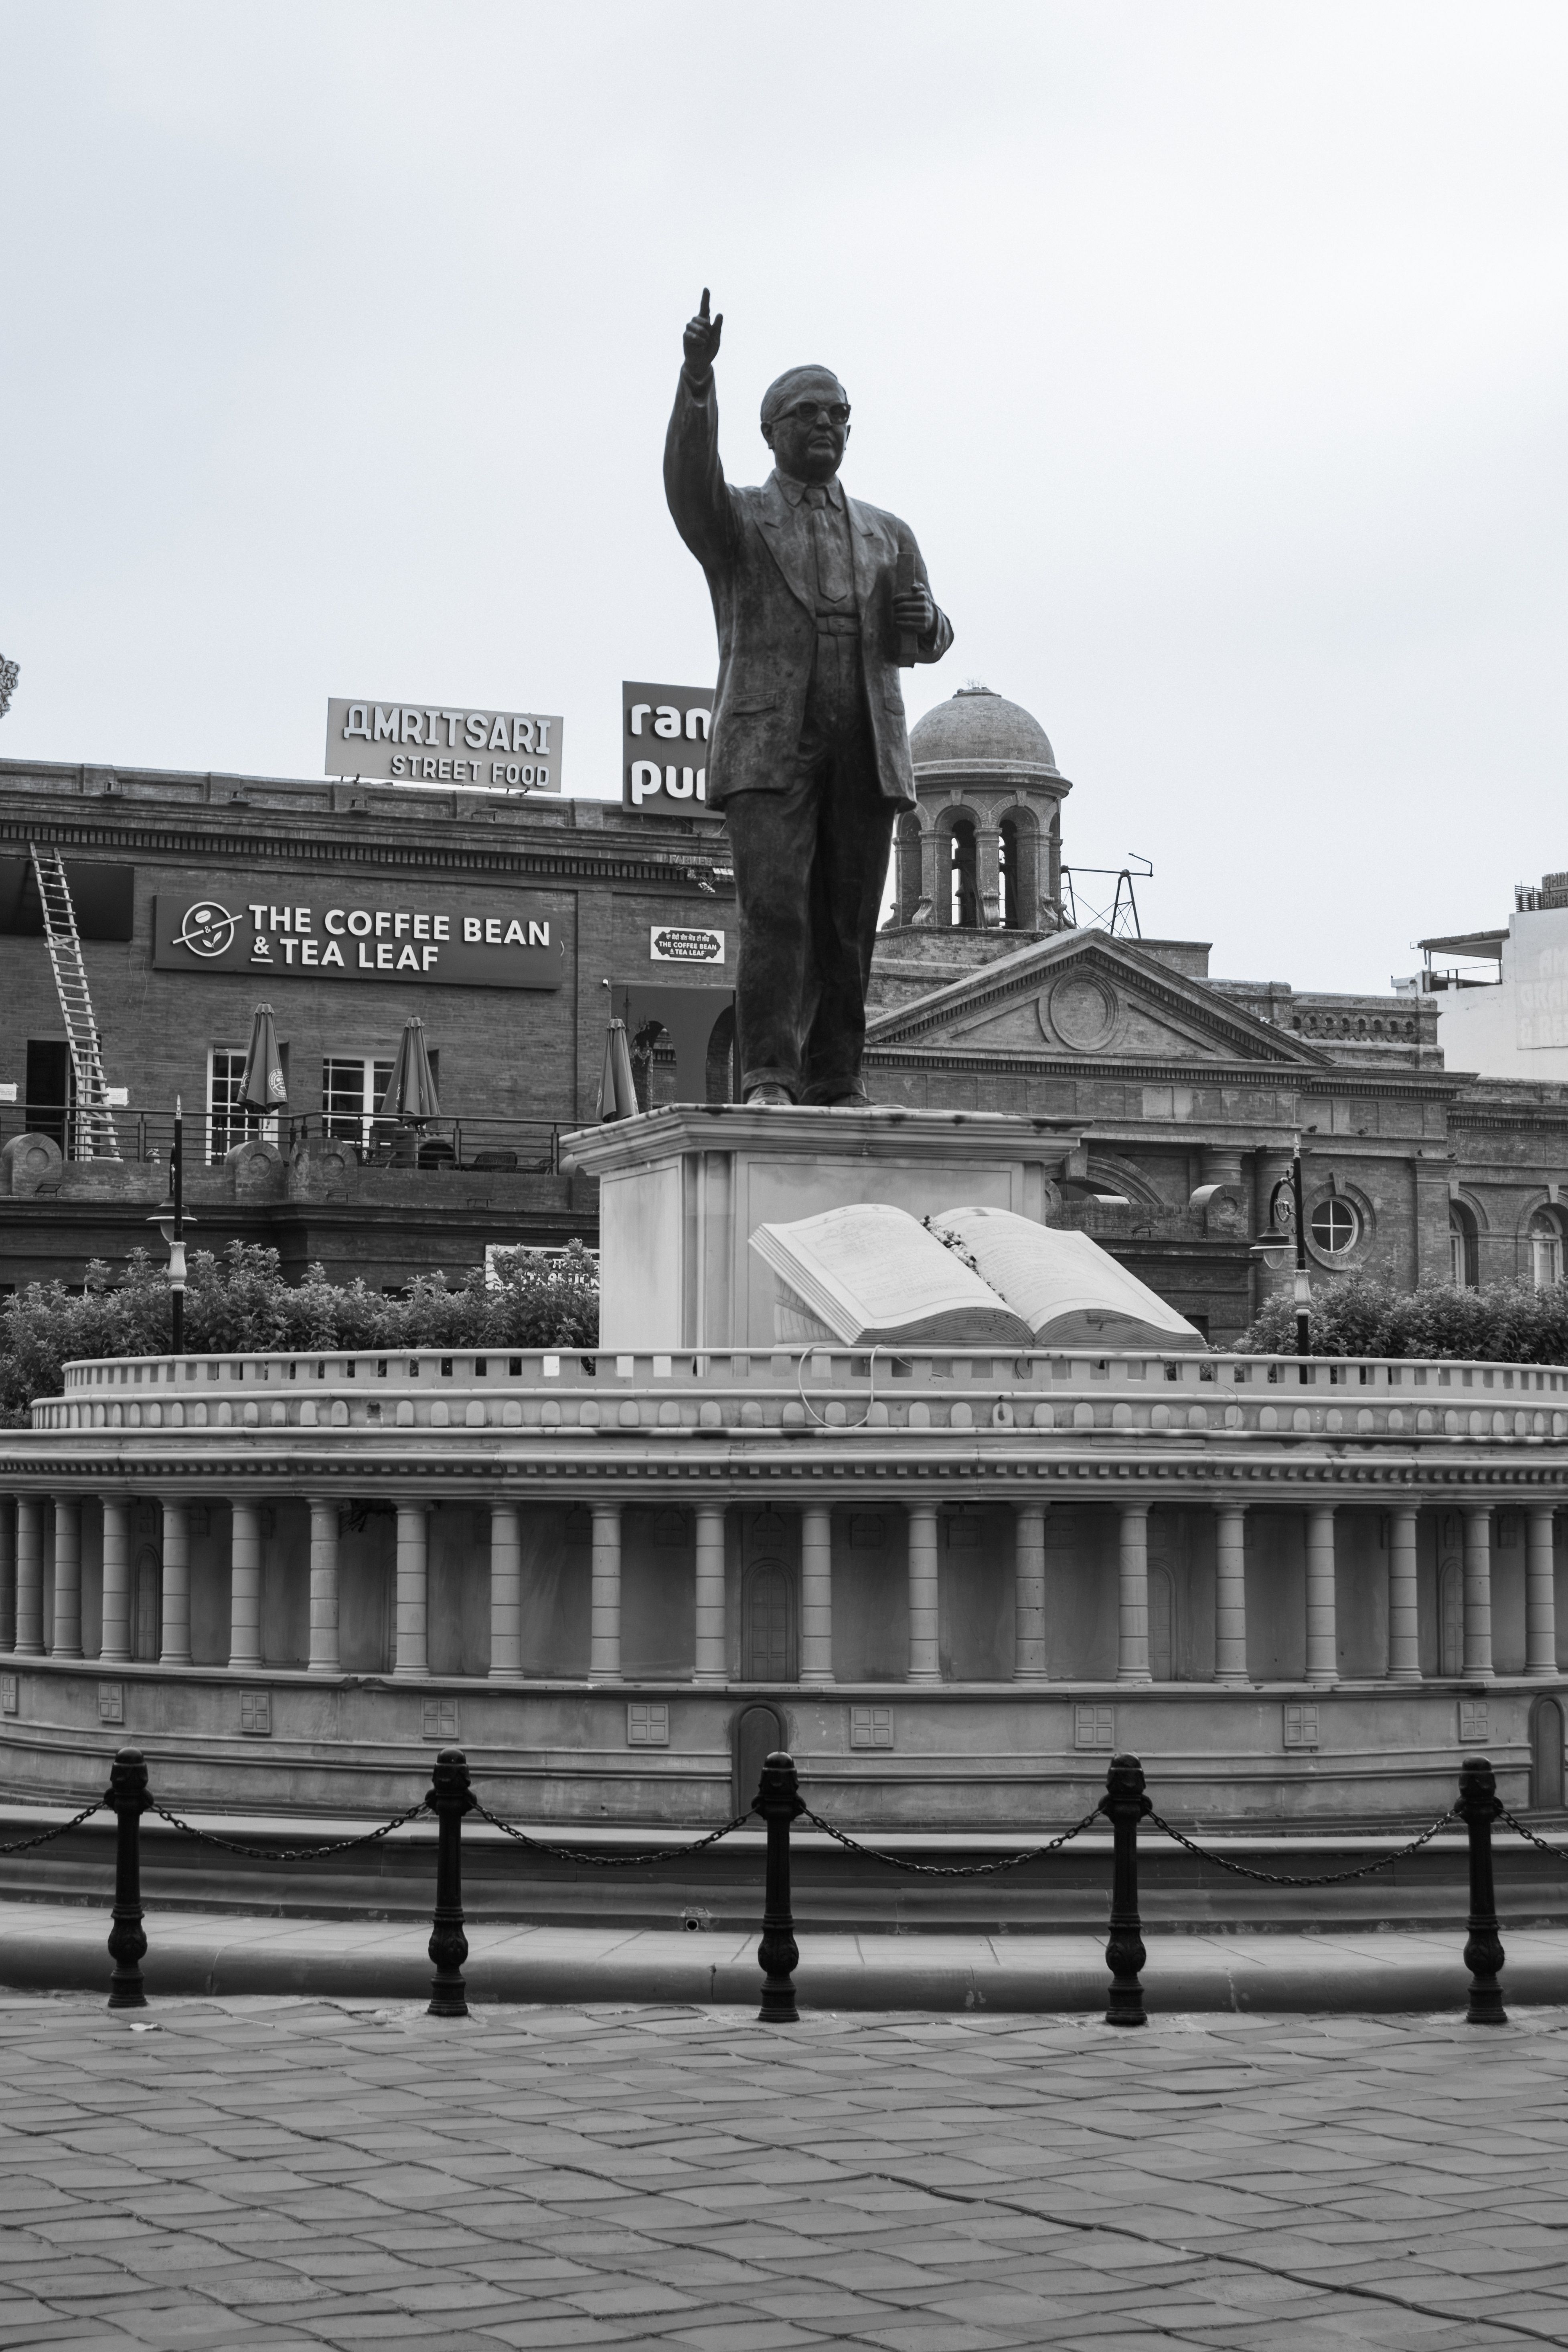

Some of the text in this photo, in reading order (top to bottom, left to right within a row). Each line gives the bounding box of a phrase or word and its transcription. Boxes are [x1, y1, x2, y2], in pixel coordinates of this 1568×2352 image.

[631, 704, 712, 739] ran
[392, 754, 550, 787] STREET FOOD
[249, 904, 549, 946] THE COFFEE BEAN
[253, 936, 438, 971] & TEA LEAF
